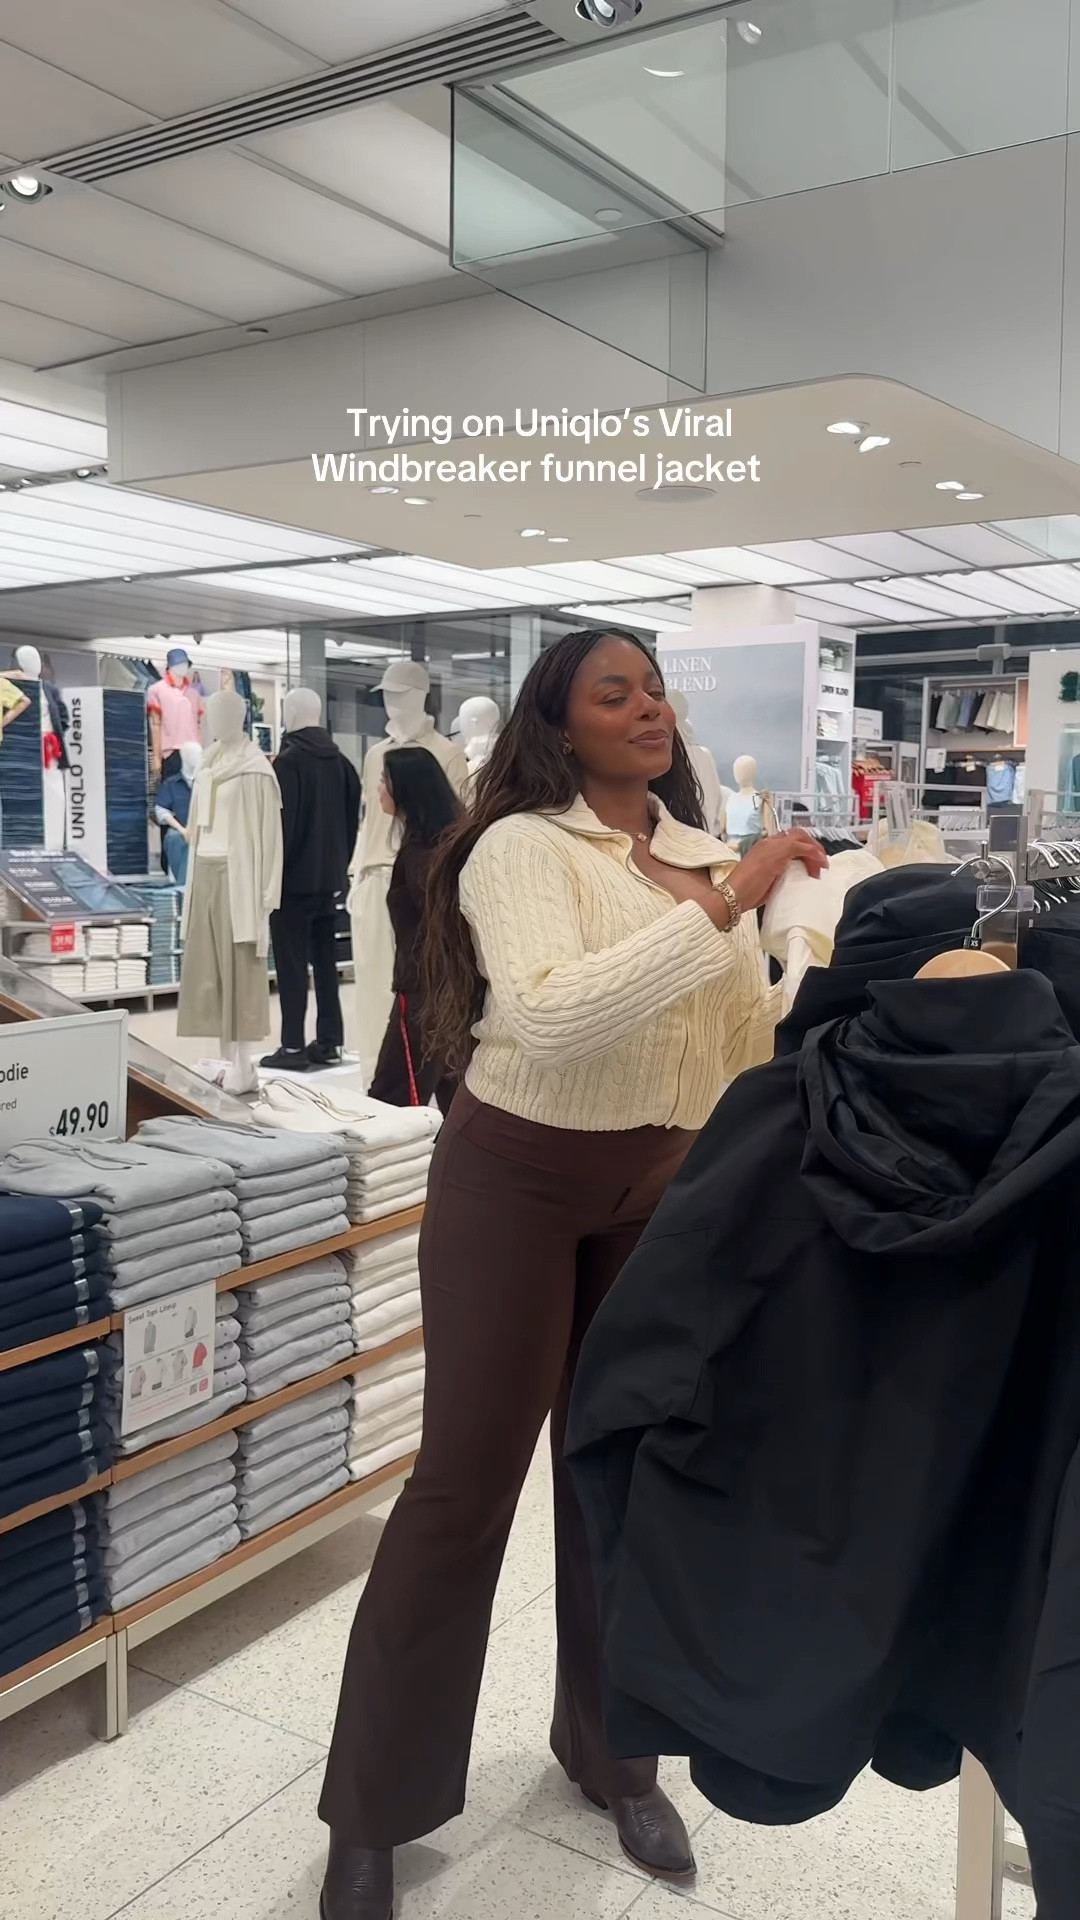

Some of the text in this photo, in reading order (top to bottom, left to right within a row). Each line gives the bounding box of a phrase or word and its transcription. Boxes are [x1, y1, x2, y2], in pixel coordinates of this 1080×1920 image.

[663, 656, 713, 673] LINEN
[69, 698, 86, 839] UNIQLO Jeans
